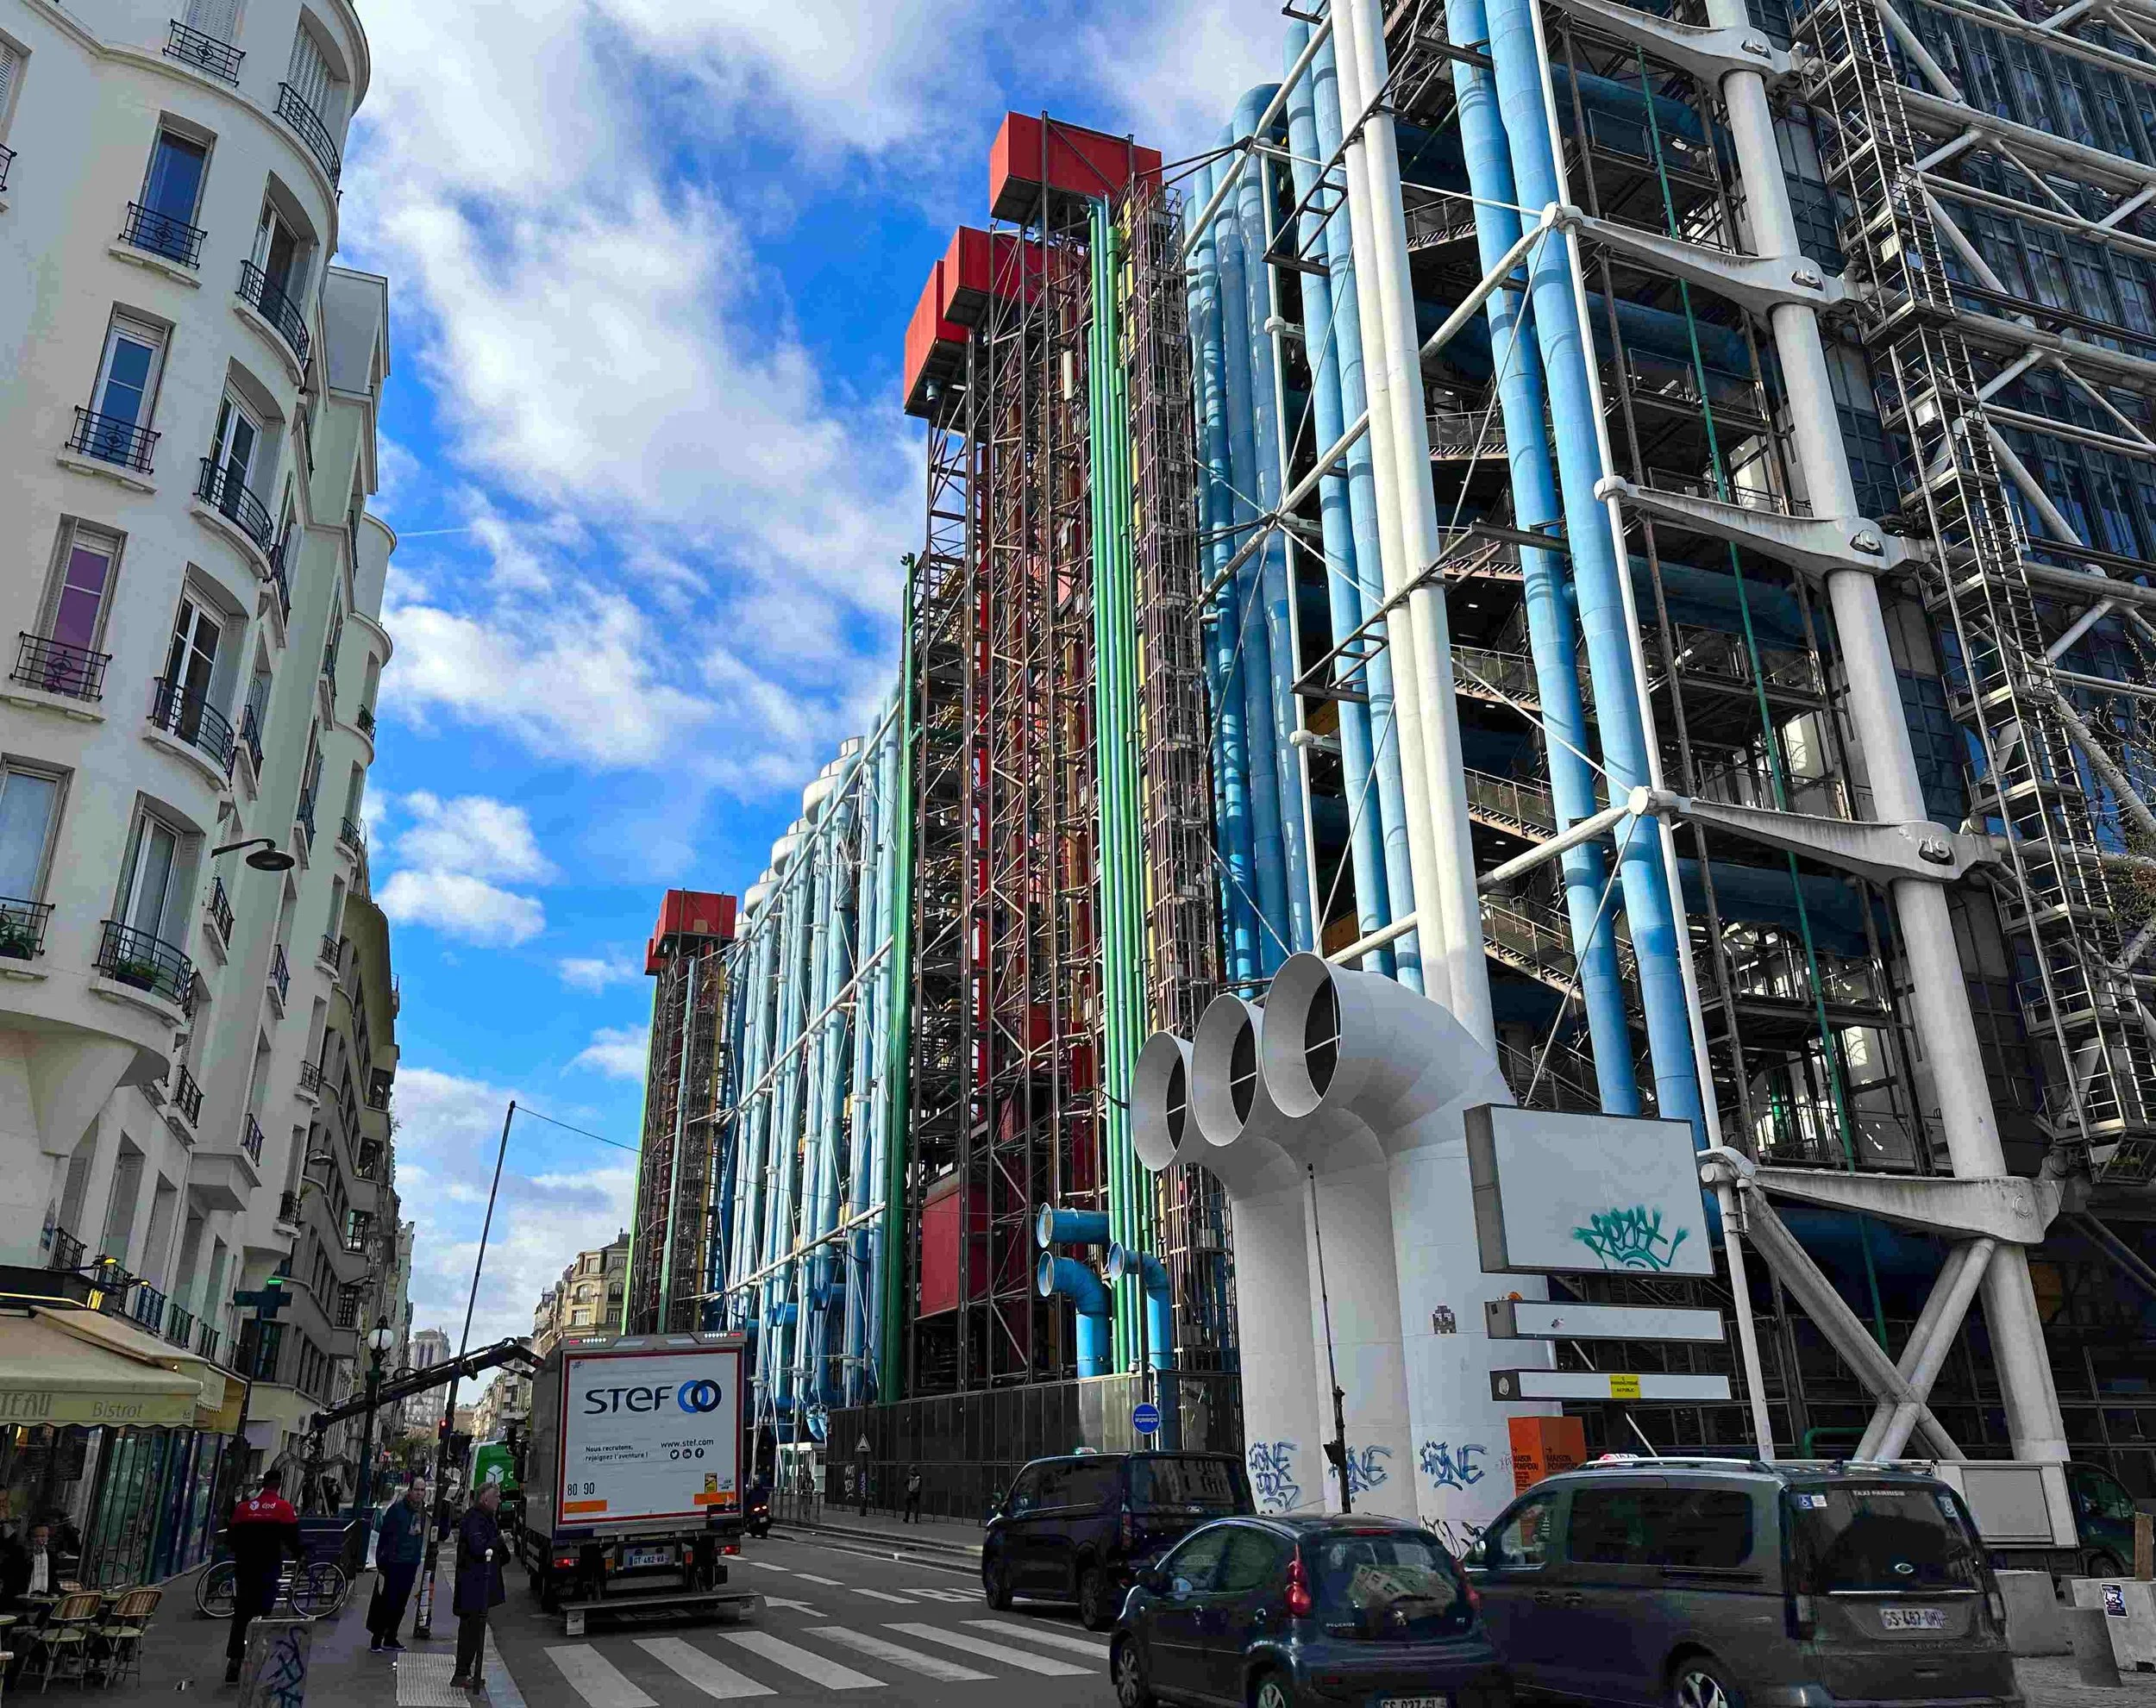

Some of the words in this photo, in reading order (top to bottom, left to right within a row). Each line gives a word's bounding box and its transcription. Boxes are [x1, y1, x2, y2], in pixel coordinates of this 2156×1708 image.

[91, 1401, 144, 1418] Bistrot
[661, 1438, 715, 1449] www.stef.com
[586, 1455, 613, 1463] rejoignez
[614, 1452, 644, 1461] l'aventure
[567, 1483, 578, 1496] 80
[583, 1482, 595, 1495] 90
